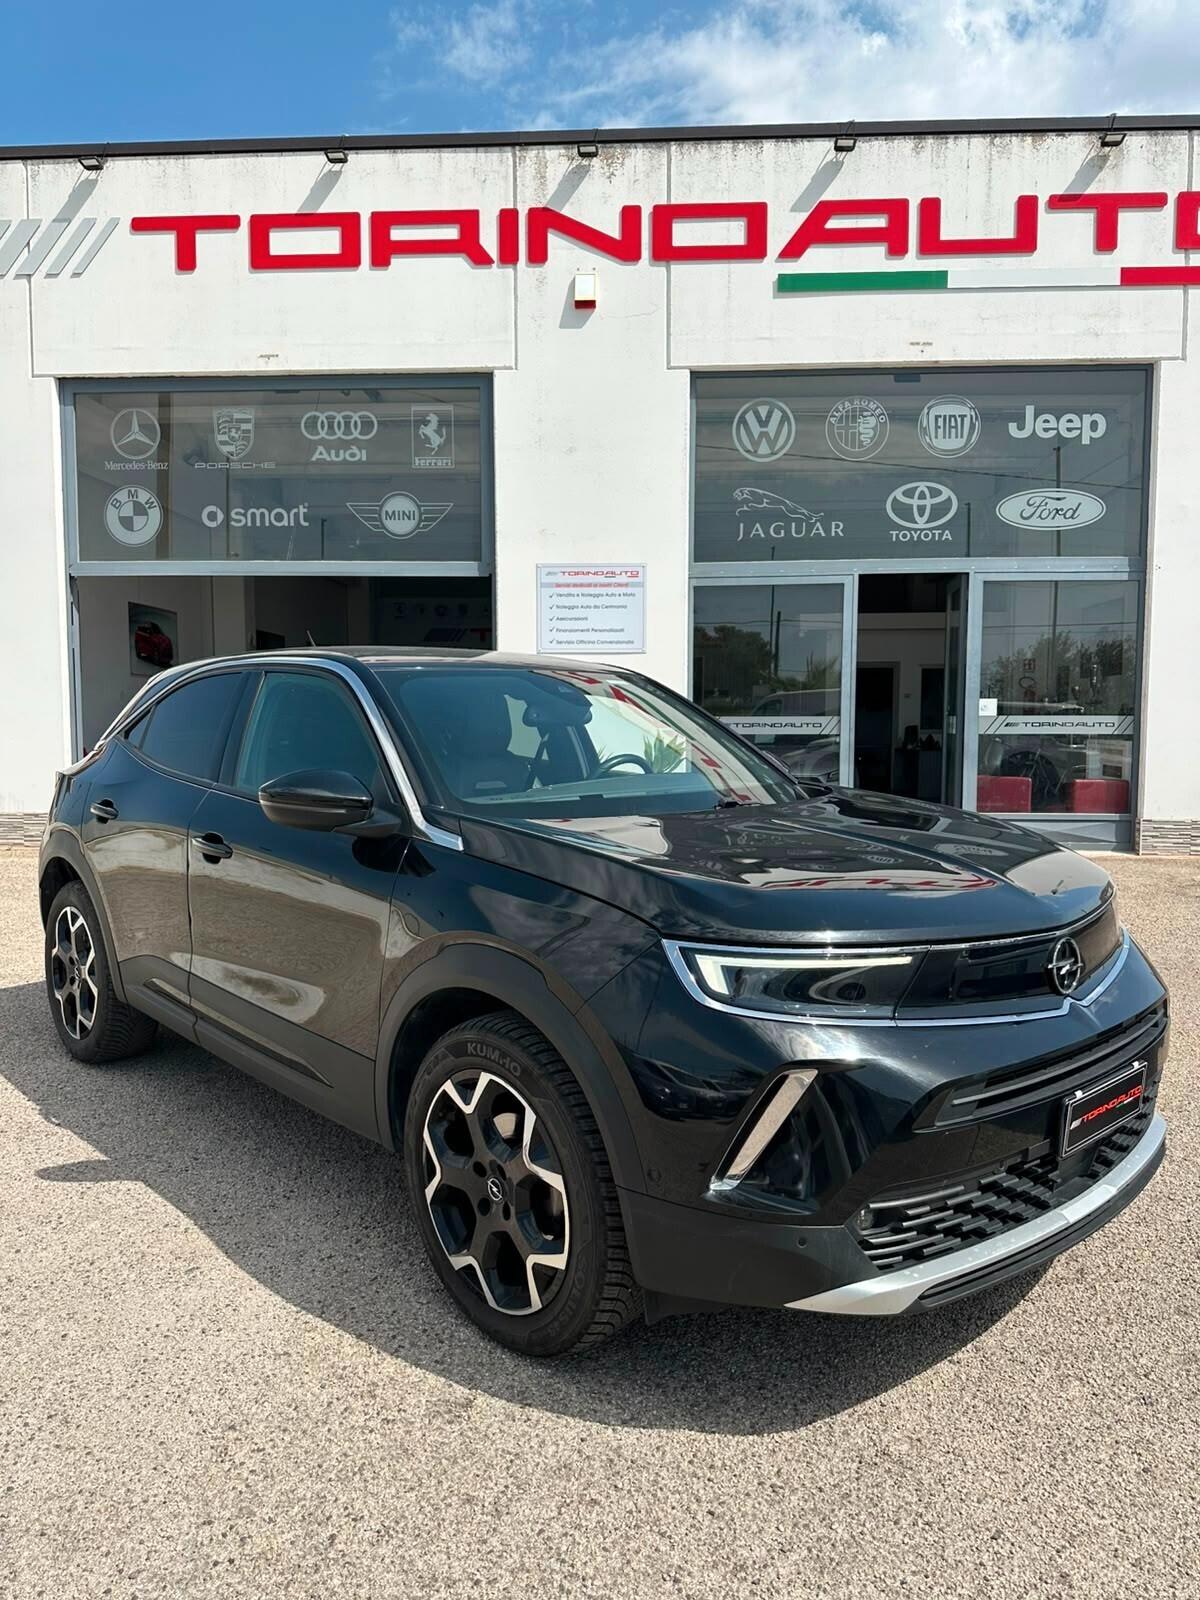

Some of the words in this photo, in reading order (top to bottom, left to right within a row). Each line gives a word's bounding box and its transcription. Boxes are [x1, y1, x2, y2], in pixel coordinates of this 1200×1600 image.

[131, 191, 1200, 272] TORINOAUT
[829, 400, 851, 425] ALFA
[853, 398, 886, 424] ROMEO
[934, 414, 968, 440] FIAT
[1008, 405, 1107, 445] Jeep
[194, 461, 276, 469] PORSCHE
[311, 445, 367, 462] Audi
[415, 458, 451, 466] Ferrari
[104, 460, 169, 471] Mercedes-Benz
[110, 488, 157, 511] BMW
[1019, 495, 1083, 521] Ford
[230, 502, 309, 528] smart
[384, 509, 416, 522] MINI
[737, 521, 845, 542] JAGUAR
[889, 529, 953, 543] TOYOTA
[1081, 1085, 1143, 1123] TORINOAUTO
